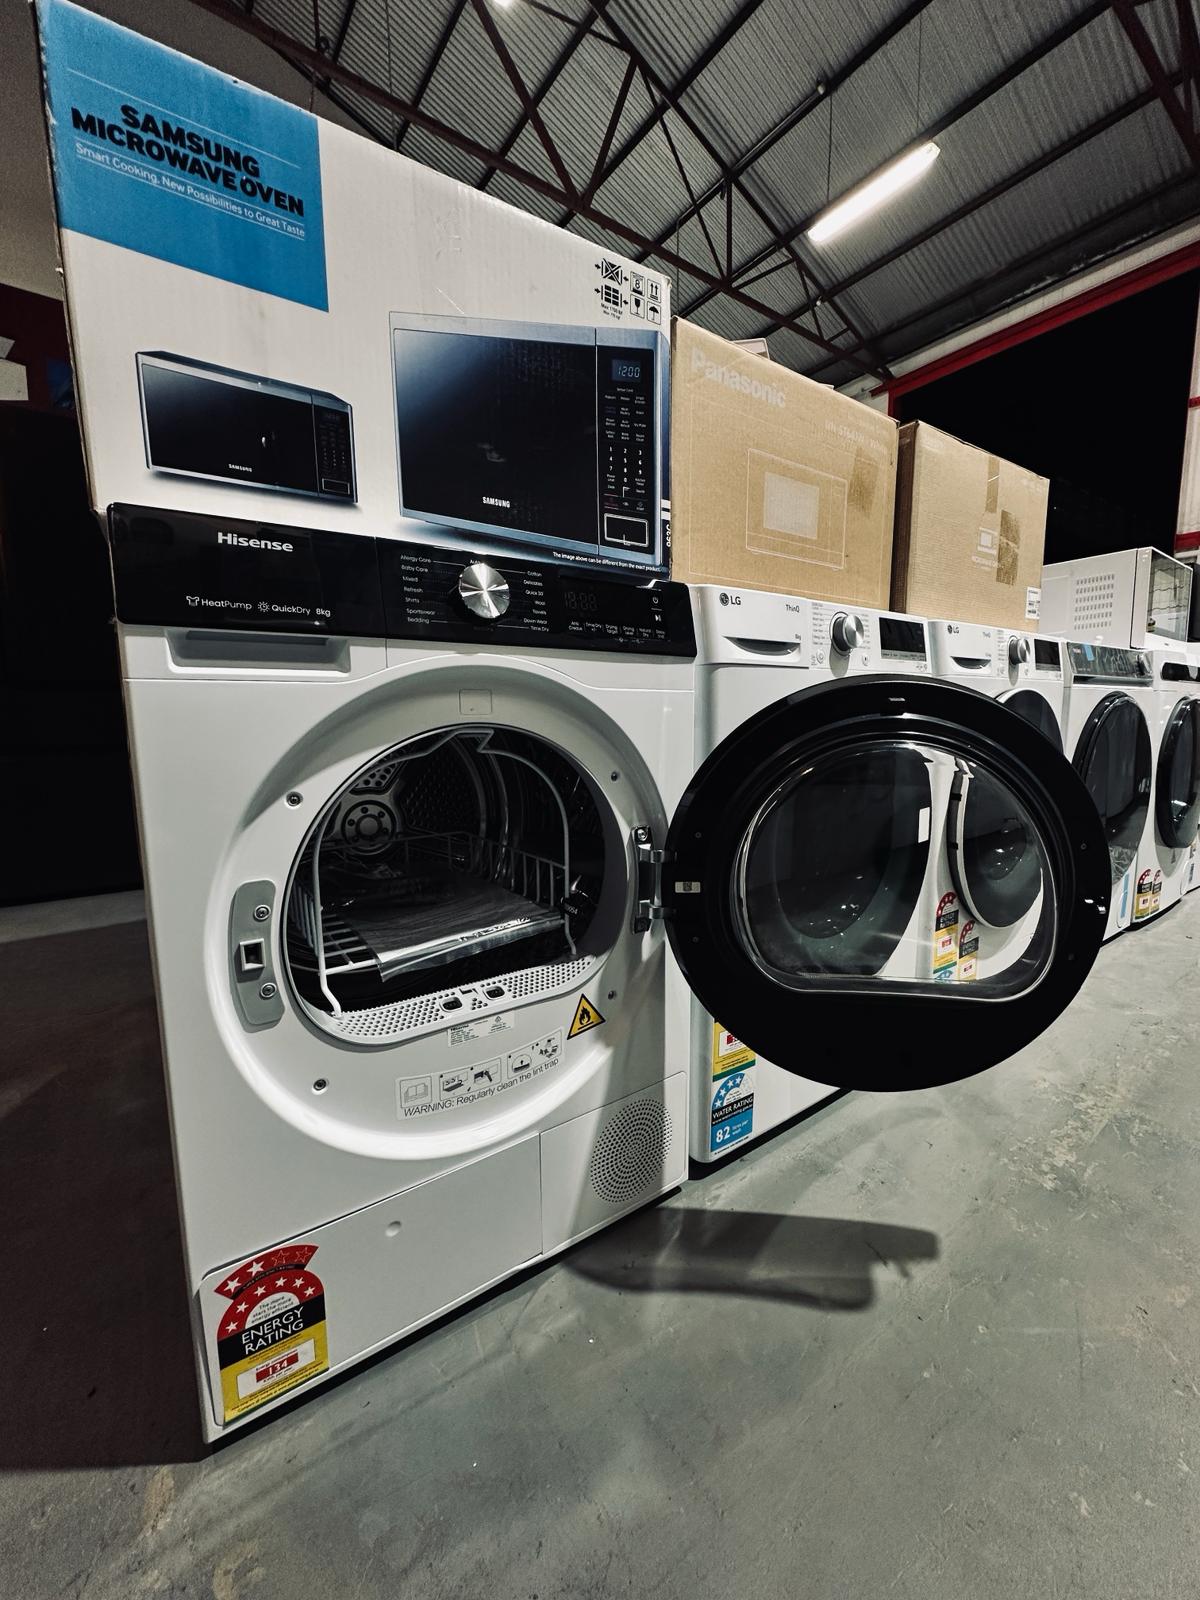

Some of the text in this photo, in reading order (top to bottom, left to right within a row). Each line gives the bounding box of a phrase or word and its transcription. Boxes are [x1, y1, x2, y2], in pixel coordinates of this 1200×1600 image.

[120, 104, 260, 178] SAMSUNG
[71, 107, 304, 217] MICROWAVE OVEN
[76, 142, 110, 164] Smart
[162, 176, 185, 193] New
[187, 184, 242, 216] Possibilities
[244, 206, 254, 219] to
[255, 211, 281, 228] Great
[281, 221, 305, 238] Taste
[618, 366, 641, 378] 1200
[691, 346, 785, 408] Panasonic
[482, 496, 511, 508] SAMSUNG
[217, 532, 294, 552] Hisense
[401, 564, 416, 572] Baby
[562, 552, 575, 561] image
[575, 554, 588, 562] above
[602, 558, 618, 567] different
[404, 586, 424, 594] Refresh
[201, 598, 331, 617] HeatPump QuickDry 8kg
[405, 596, 420, 604] Shirts
[730, 595, 741, 606] LG
[786, 604, 800, 614] ThinQ
[408, 616, 430, 624] Bedding
[952, 626, 960, 634] LG
[404, 1058, 560, 1117] WARNING: Regularly clean the lint trap
[712, 1106, 733, 1120] WATER
[733, 1096, 753, 1110] RATING
[716, 1126, 731, 1143] 82
[252, 1298, 292, 1318] stars the more
[260, 1296, 285, 1310] The more
[251, 1302, 294, 1324] energy efficient
[242, 1306, 304, 1344] ENERGY
[245, 1319, 304, 1355] RATING
[268, 1359, 288, 1375] 134
